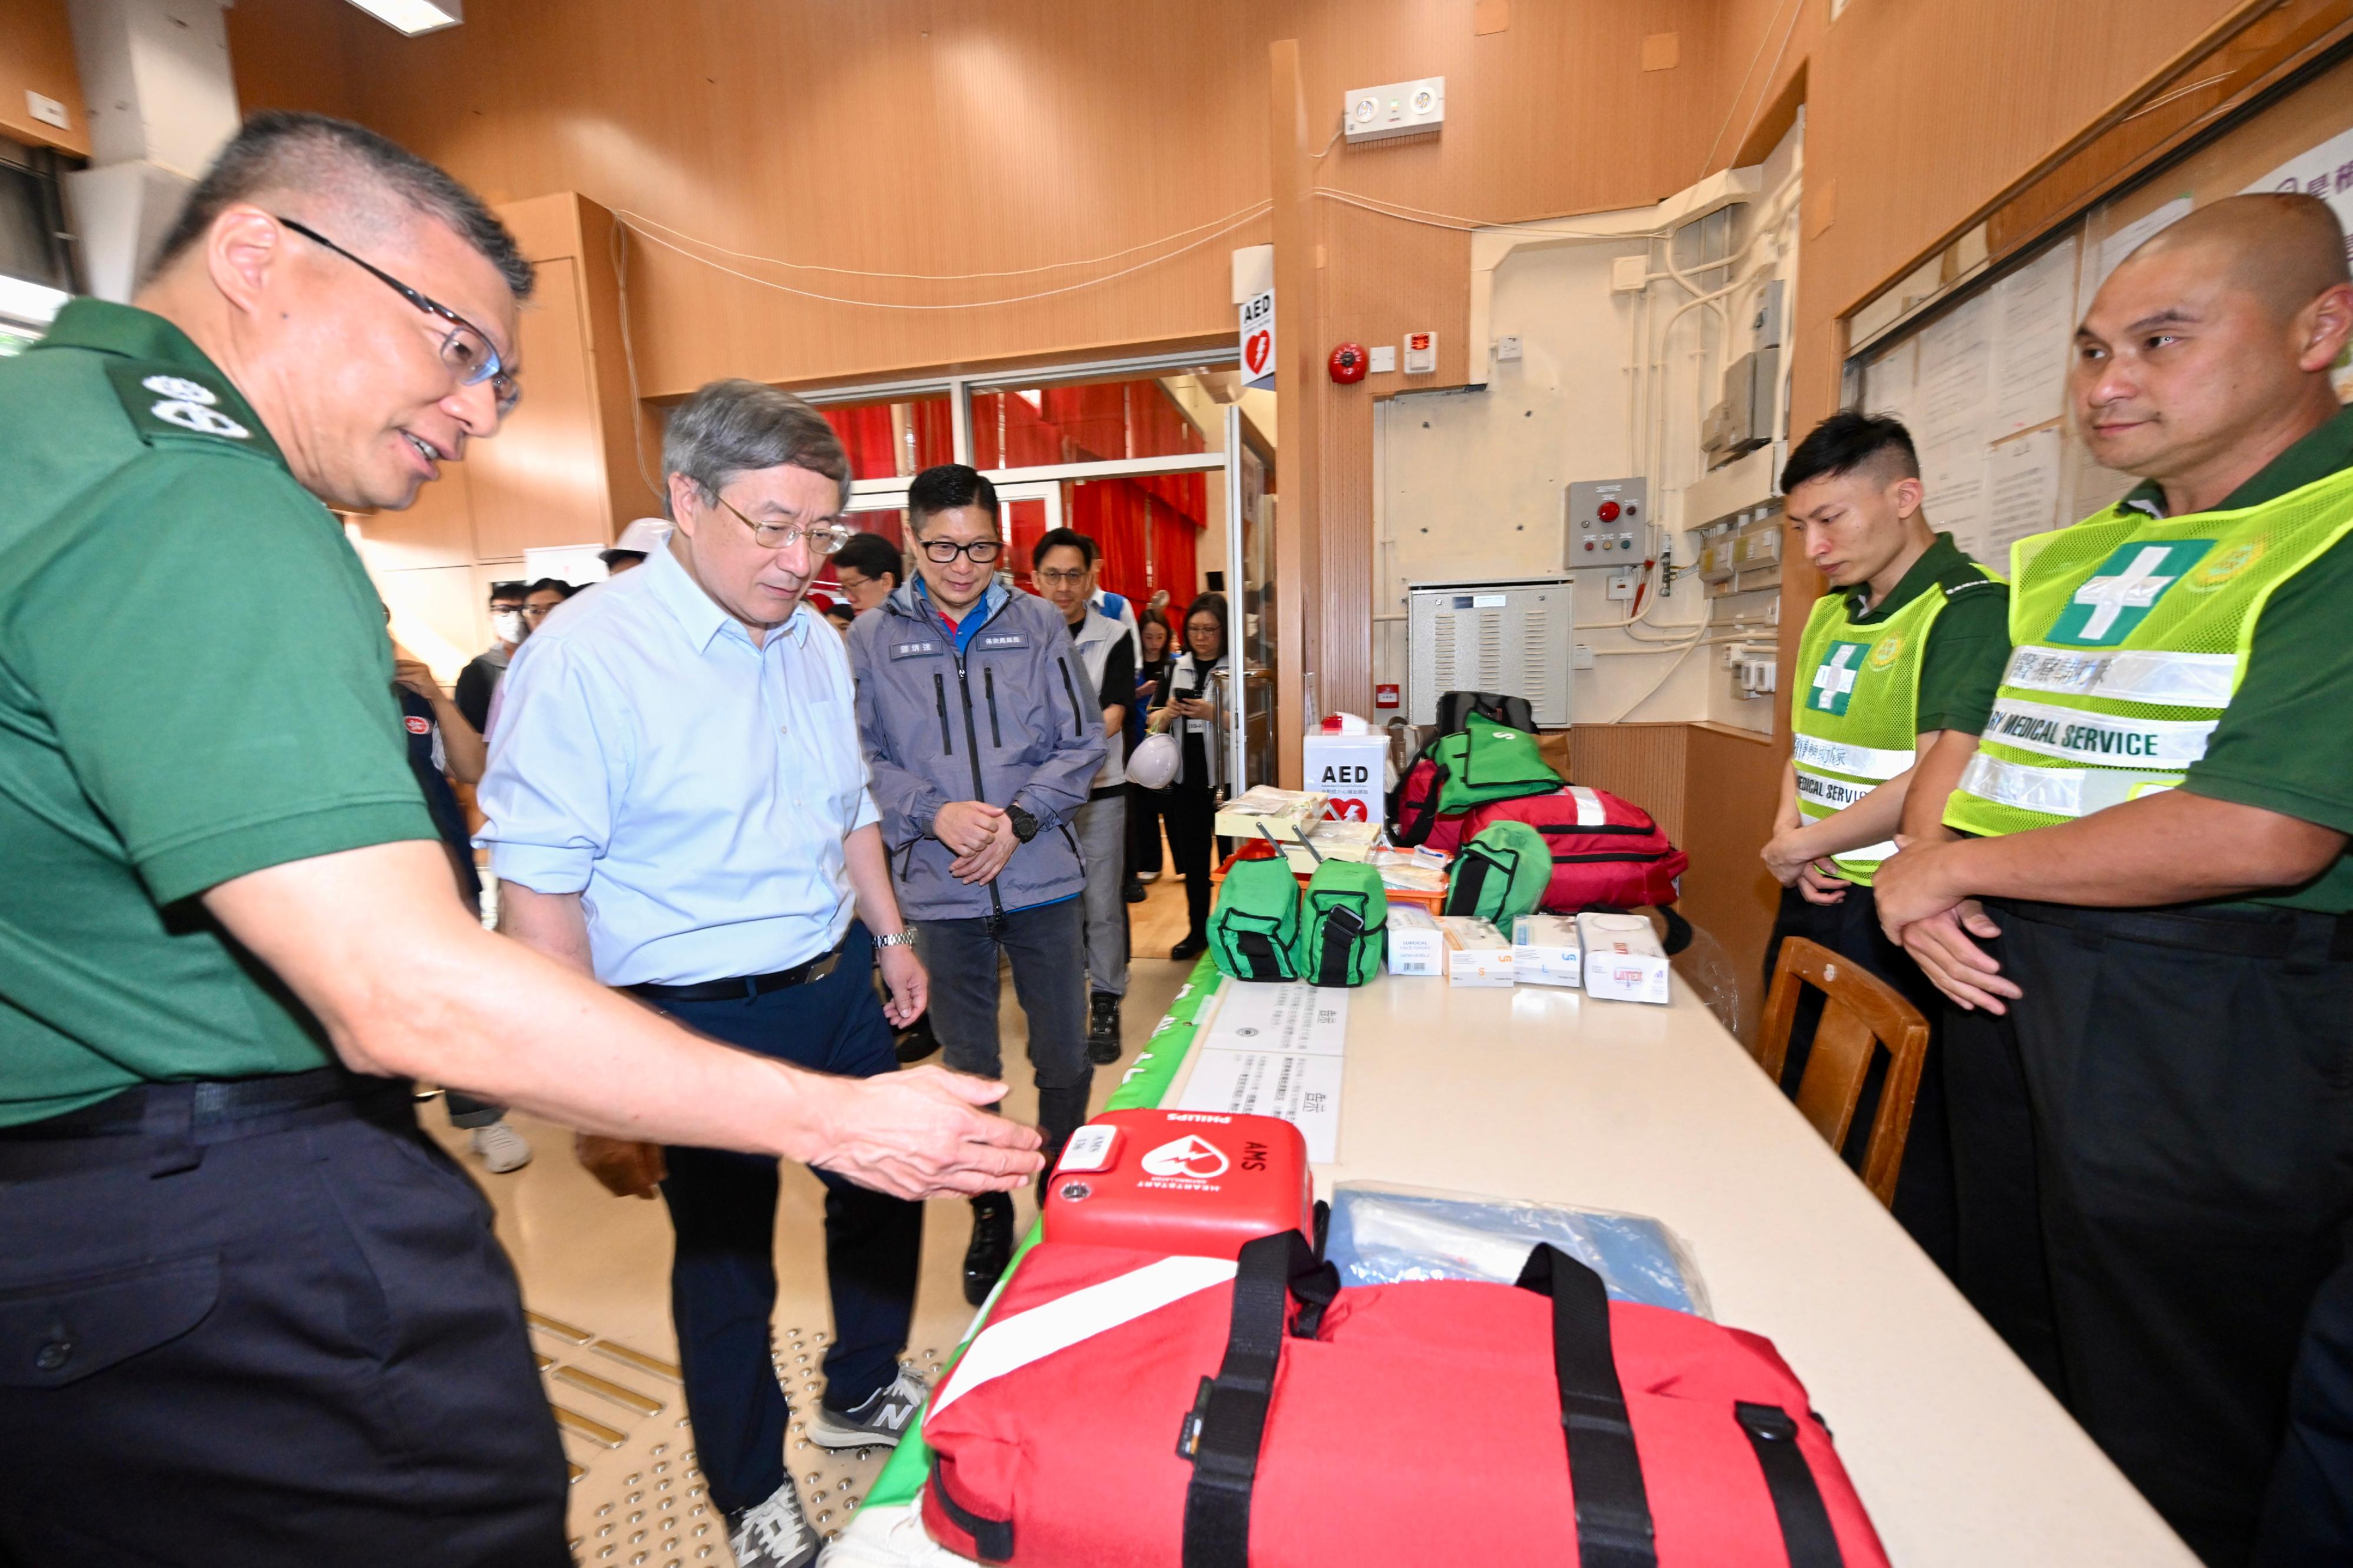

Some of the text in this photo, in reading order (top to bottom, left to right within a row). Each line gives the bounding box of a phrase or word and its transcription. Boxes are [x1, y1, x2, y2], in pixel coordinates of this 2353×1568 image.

[1244, 295, 1270, 323] AED
[1334, 348, 1361, 363] FIRE ALARM
[985, 636, 1019, 645] 保安局局長
[2002, 714, 2059, 745] MEDICAL
[2062, 724, 2158, 756] SERVICE
[1321, 766, 1368, 783] AED
[1826, 784, 1867, 803] SERVI
[1478, 968, 1485, 976] S
[1542, 965, 1548, 973] L
[1614, 970, 1643, 982] LATEX
[1318, 1009, 1338, 1024] 告示
[1305, 1092, 1327, 1113] 告示
[1166, 1113, 1232, 1124] PHILIPS
[1241, 1141, 1268, 1171] AMS
[1136, 1180, 1221, 1192] HEARTSTART
[872, 1404, 914, 1430] N
